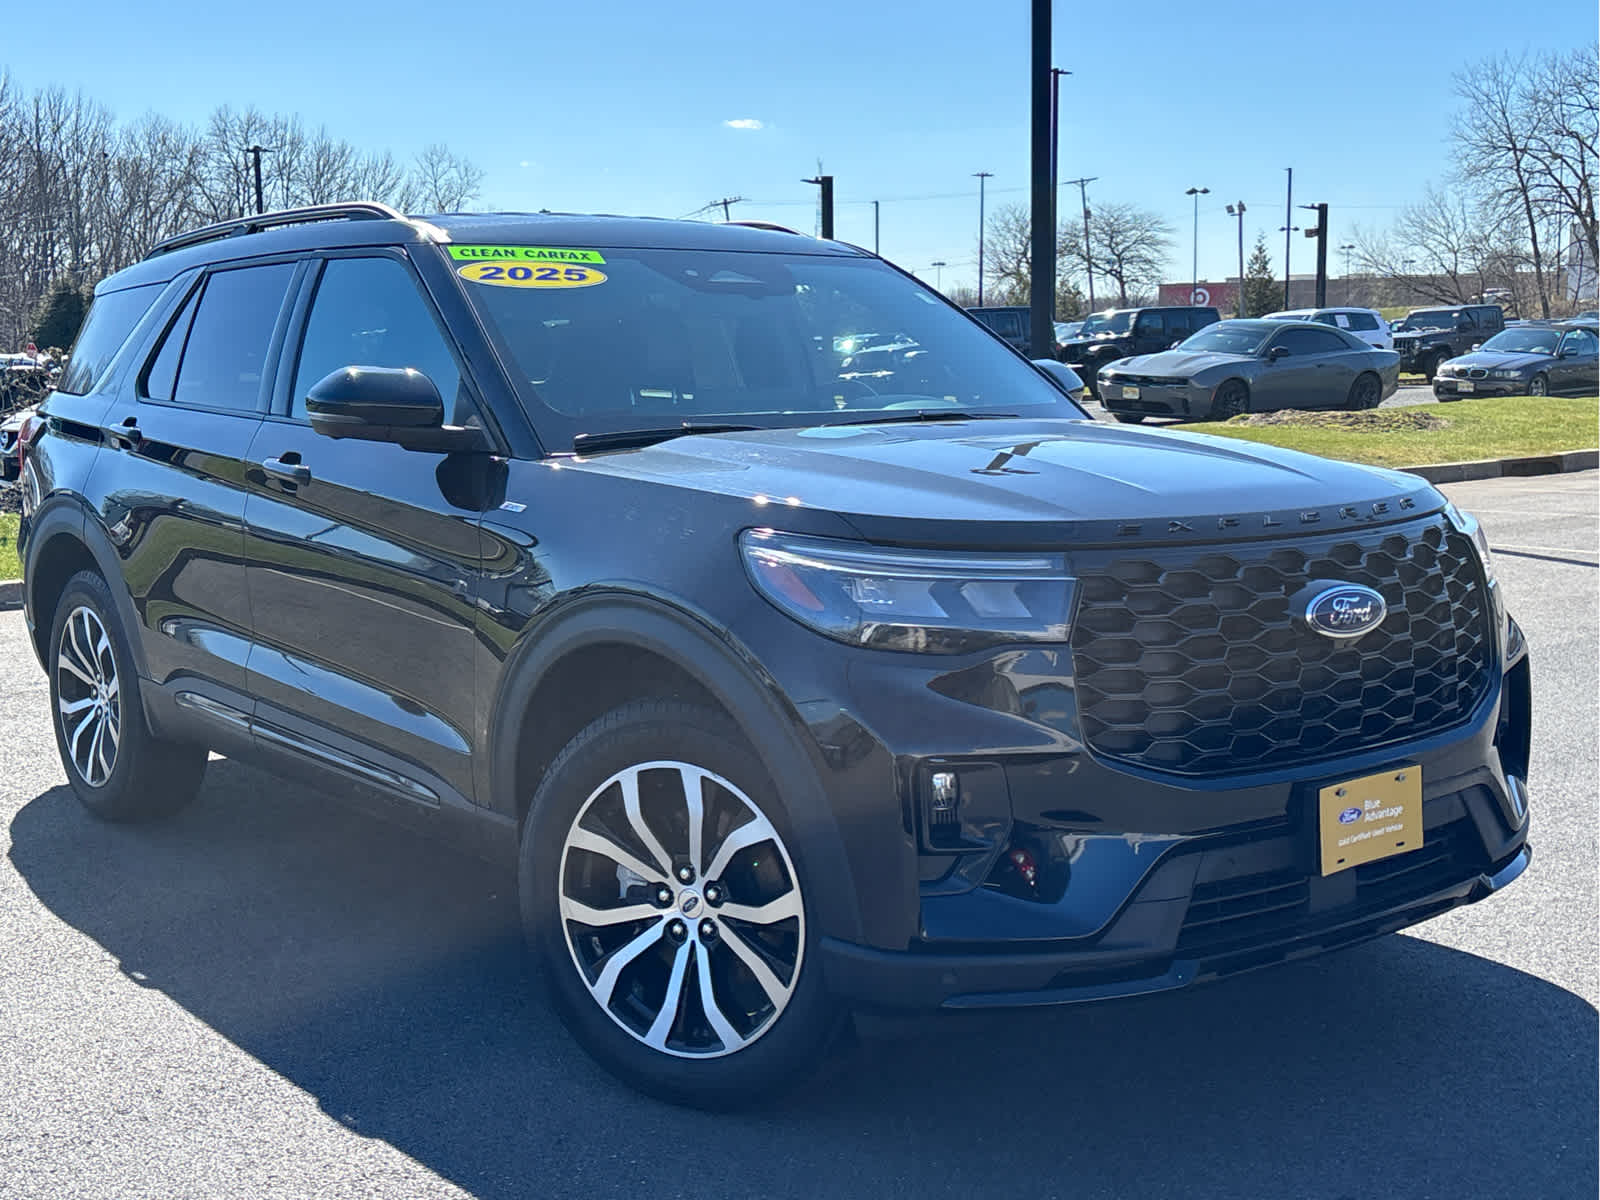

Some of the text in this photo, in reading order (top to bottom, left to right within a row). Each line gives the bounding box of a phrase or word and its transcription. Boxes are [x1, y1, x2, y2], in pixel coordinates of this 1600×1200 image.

[459, 248, 592, 261] CLEAN CARFAX
[479, 266, 588, 282] 2025
[1330, 596, 1372, 625] Ford
